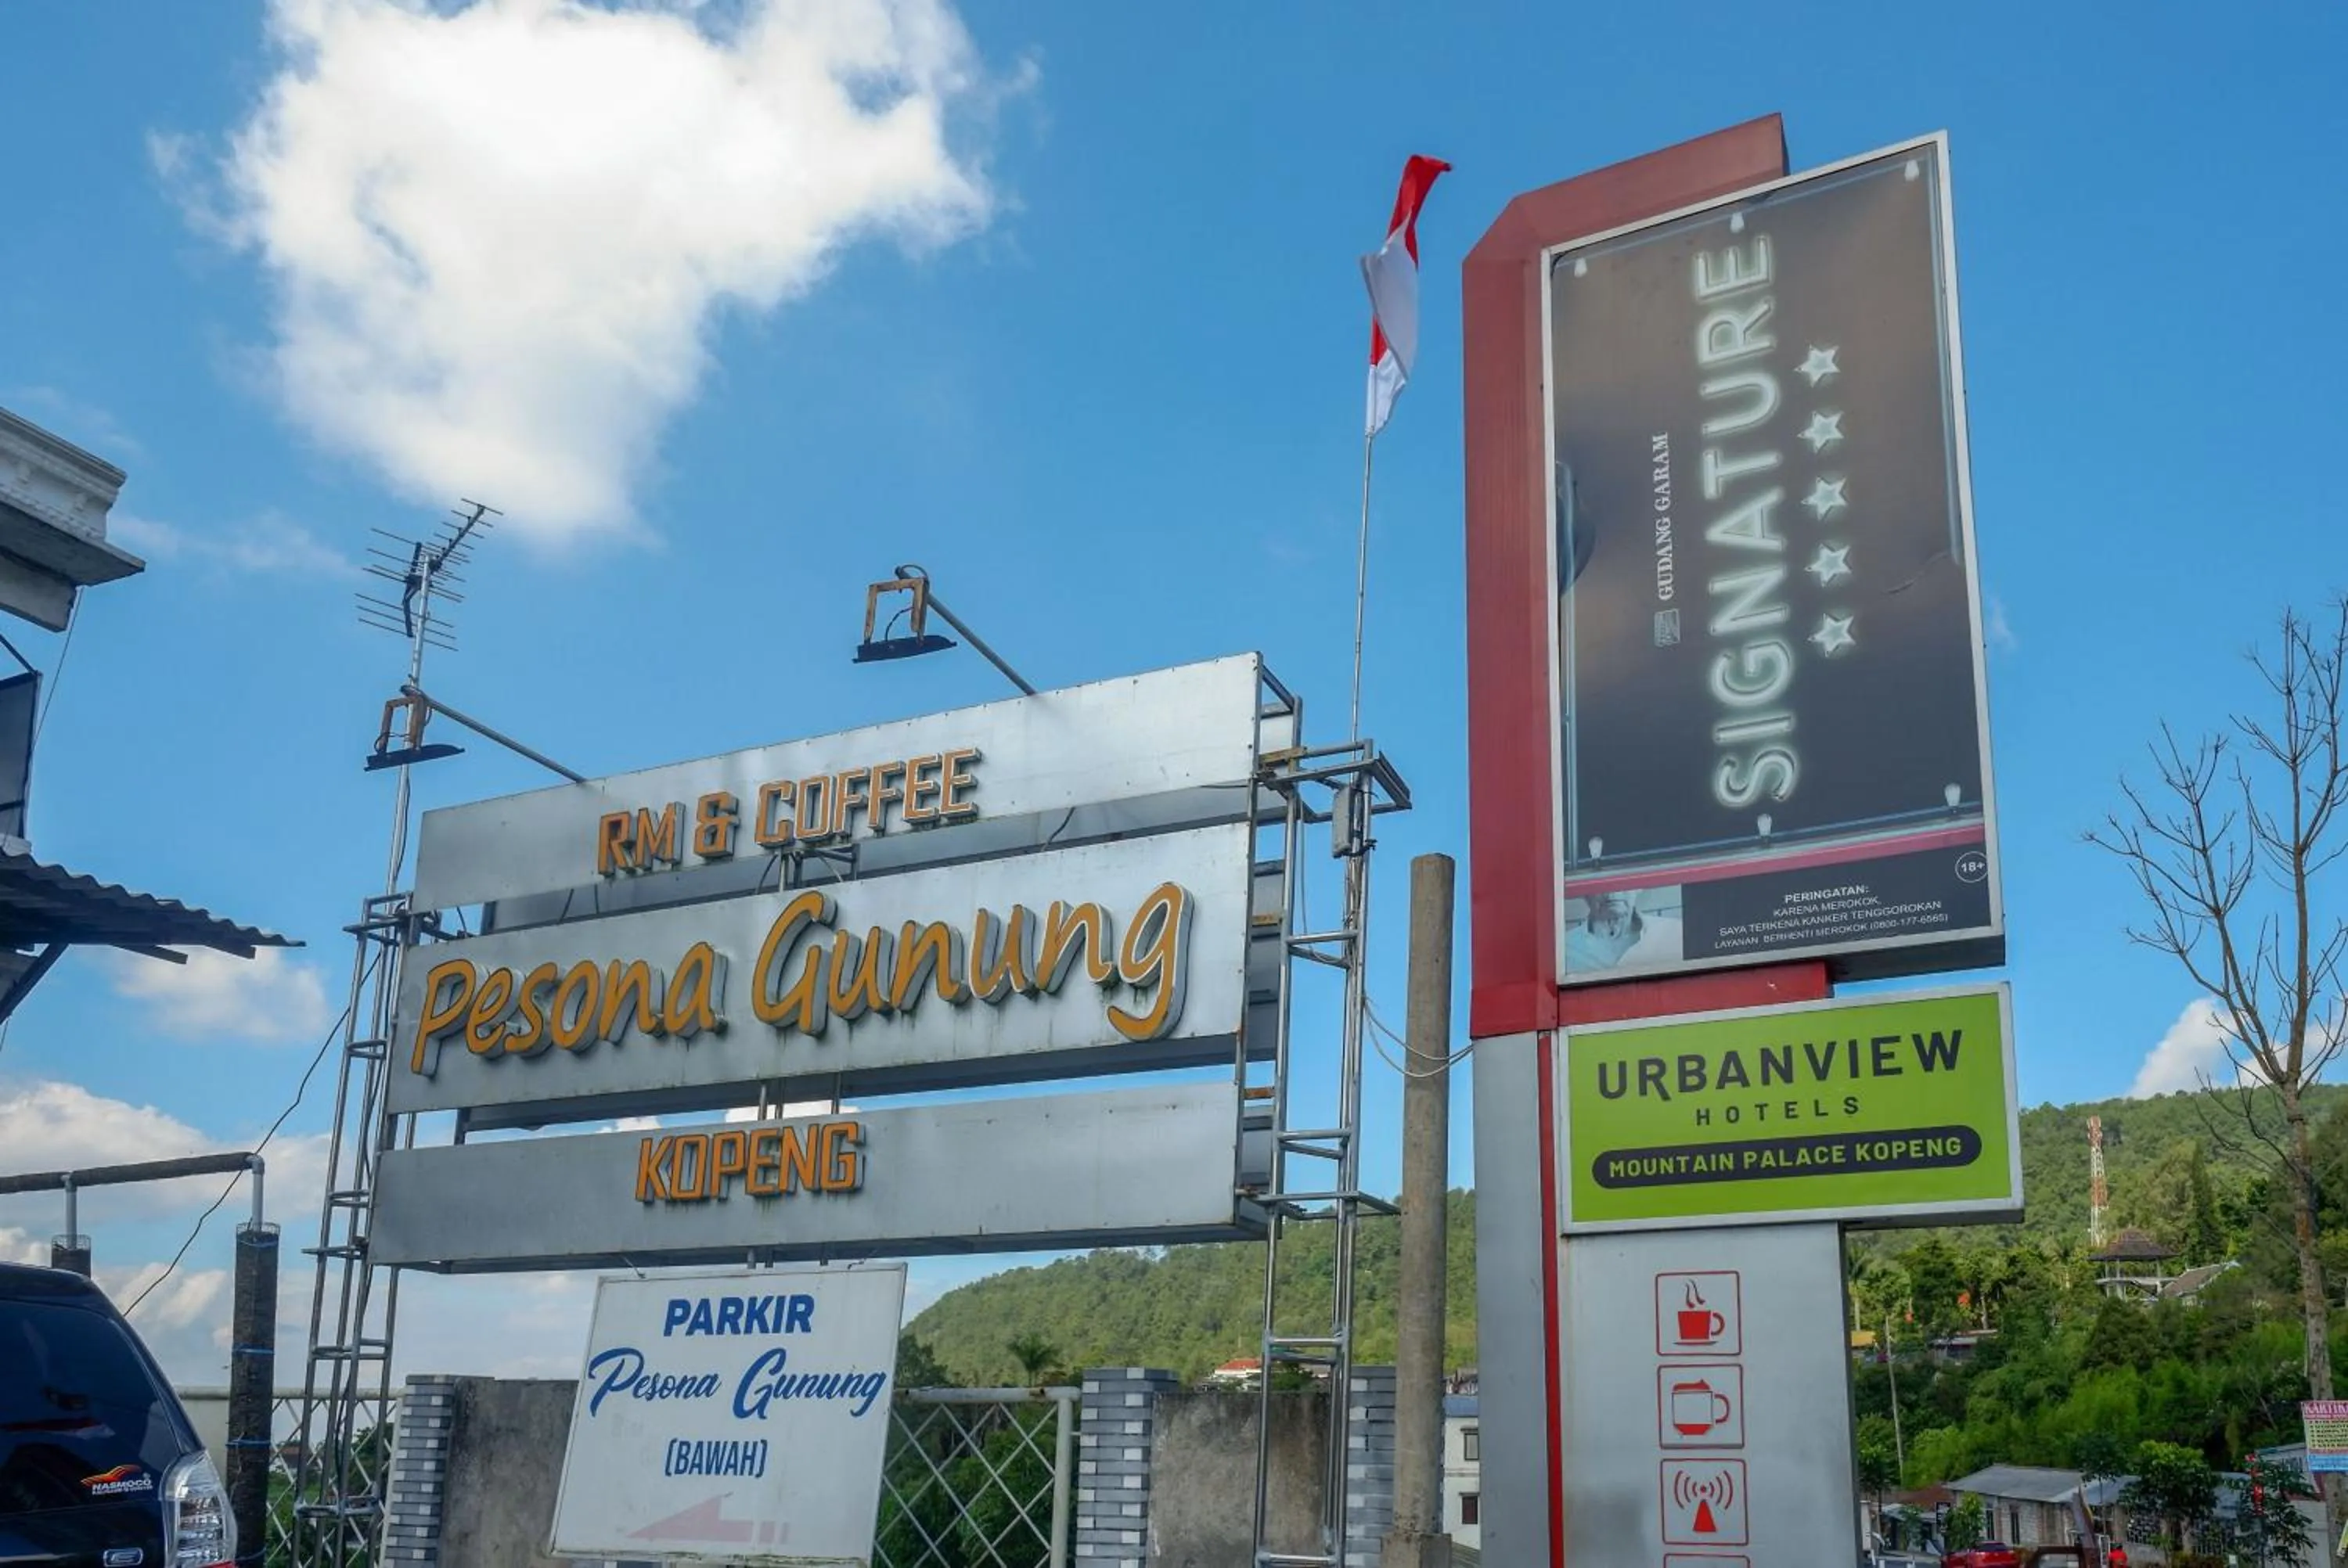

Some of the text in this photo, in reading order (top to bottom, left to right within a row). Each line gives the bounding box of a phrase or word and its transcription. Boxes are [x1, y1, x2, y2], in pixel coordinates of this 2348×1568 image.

[1652, 432, 1673, 601] GUDANG GARAM
[1695, 235, 1799, 807] SIGNATURE
[598, 747, 982, 876] RM & COFFEE
[1961, 861, 1985, 872] 18+
[1773, 904, 1820, 916] KARENA
[1784, 885, 1870, 904] PERINGATAN:
[1715, 937, 1759, 949] LAYANAN
[1816, 922, 1870, 937] MEROKOK
[1720, 901, 1942, 937] SAYA TERKENA KANKER TENGGOROKAN
[412, 882, 1193, 1077] Pesona Gunung
[1597, 1029, 1963, 1101] URBANVIEW
[1695, 1096, 1860, 1127] HOTELS
[636, 1121, 866, 1203] KOPENG
[1609, 1136, 1963, 1178] MOUNTAIN PALACE KOPENG
[664, 1294, 815, 1336] PARKIR
[588, 1346, 887, 1419] Pesona Gunung
